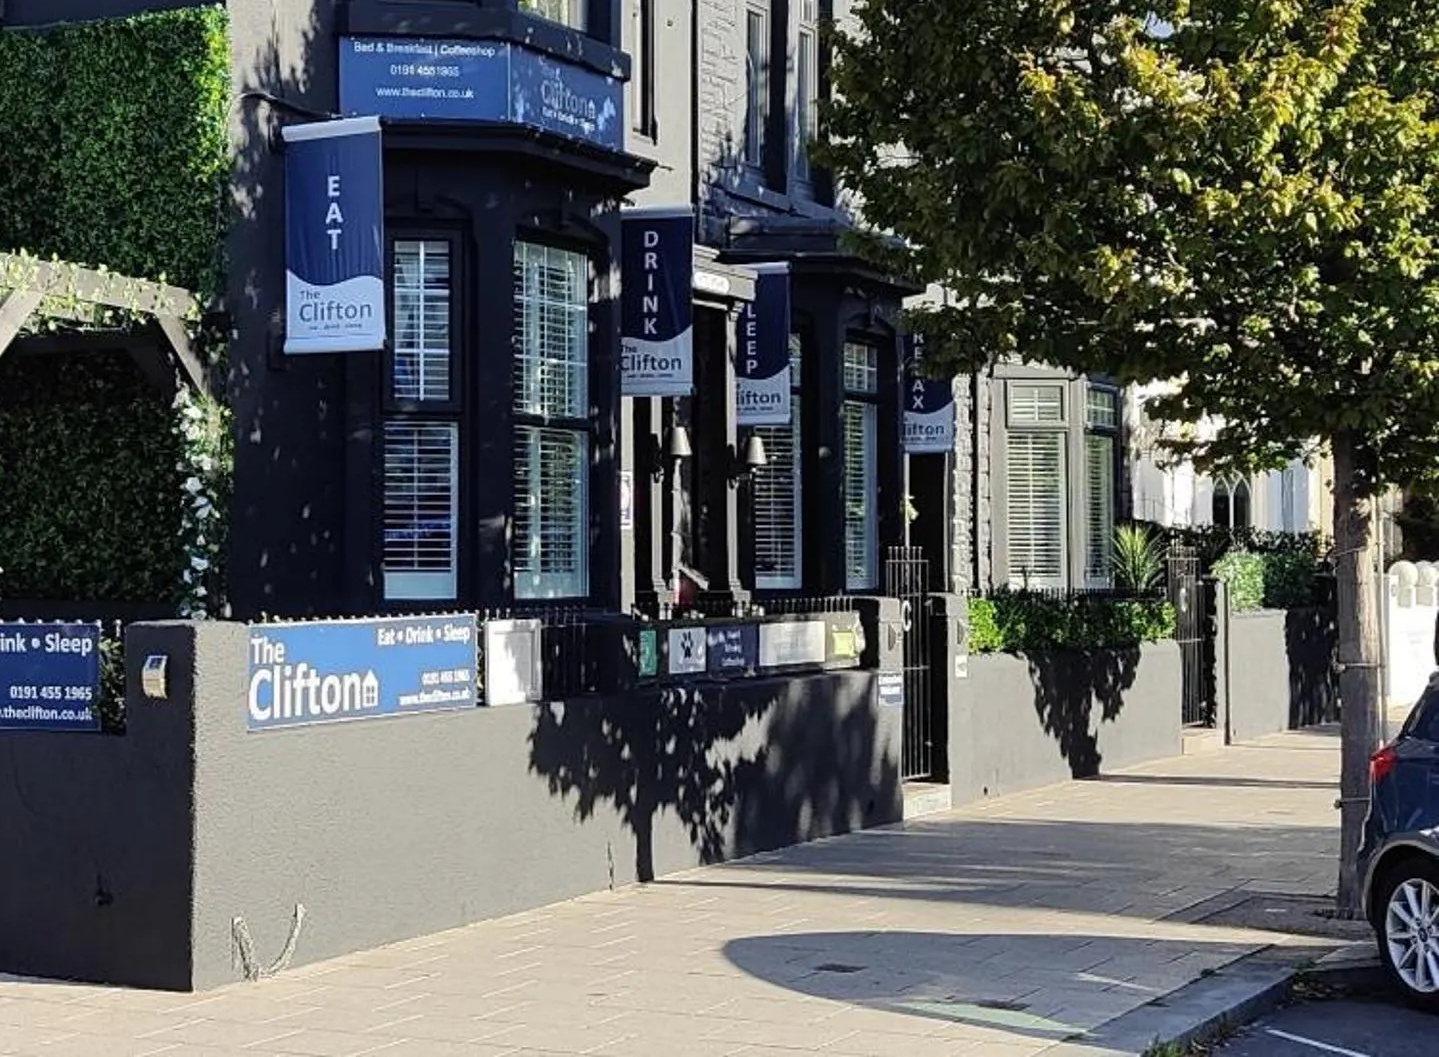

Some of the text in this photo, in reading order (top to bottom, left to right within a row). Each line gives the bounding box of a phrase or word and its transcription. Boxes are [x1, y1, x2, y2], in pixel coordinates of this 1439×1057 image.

[325, 175, 344, 250] EAT
[300, 289, 321, 300] The
[643, 230, 659, 335] DRINK
[299, 300, 372, 322] Clifton
[746, 303, 758, 374] LEEP
[620, 353, 682, 371] Clifton
[45, 632, 93, 657] Sleep
[377, 623, 471, 646] Eat Drink Sleep
[250, 636, 285, 664] The
[10, 685, 93, 701] 0191 455 1965
[249, 662, 361, 720] Clifton
